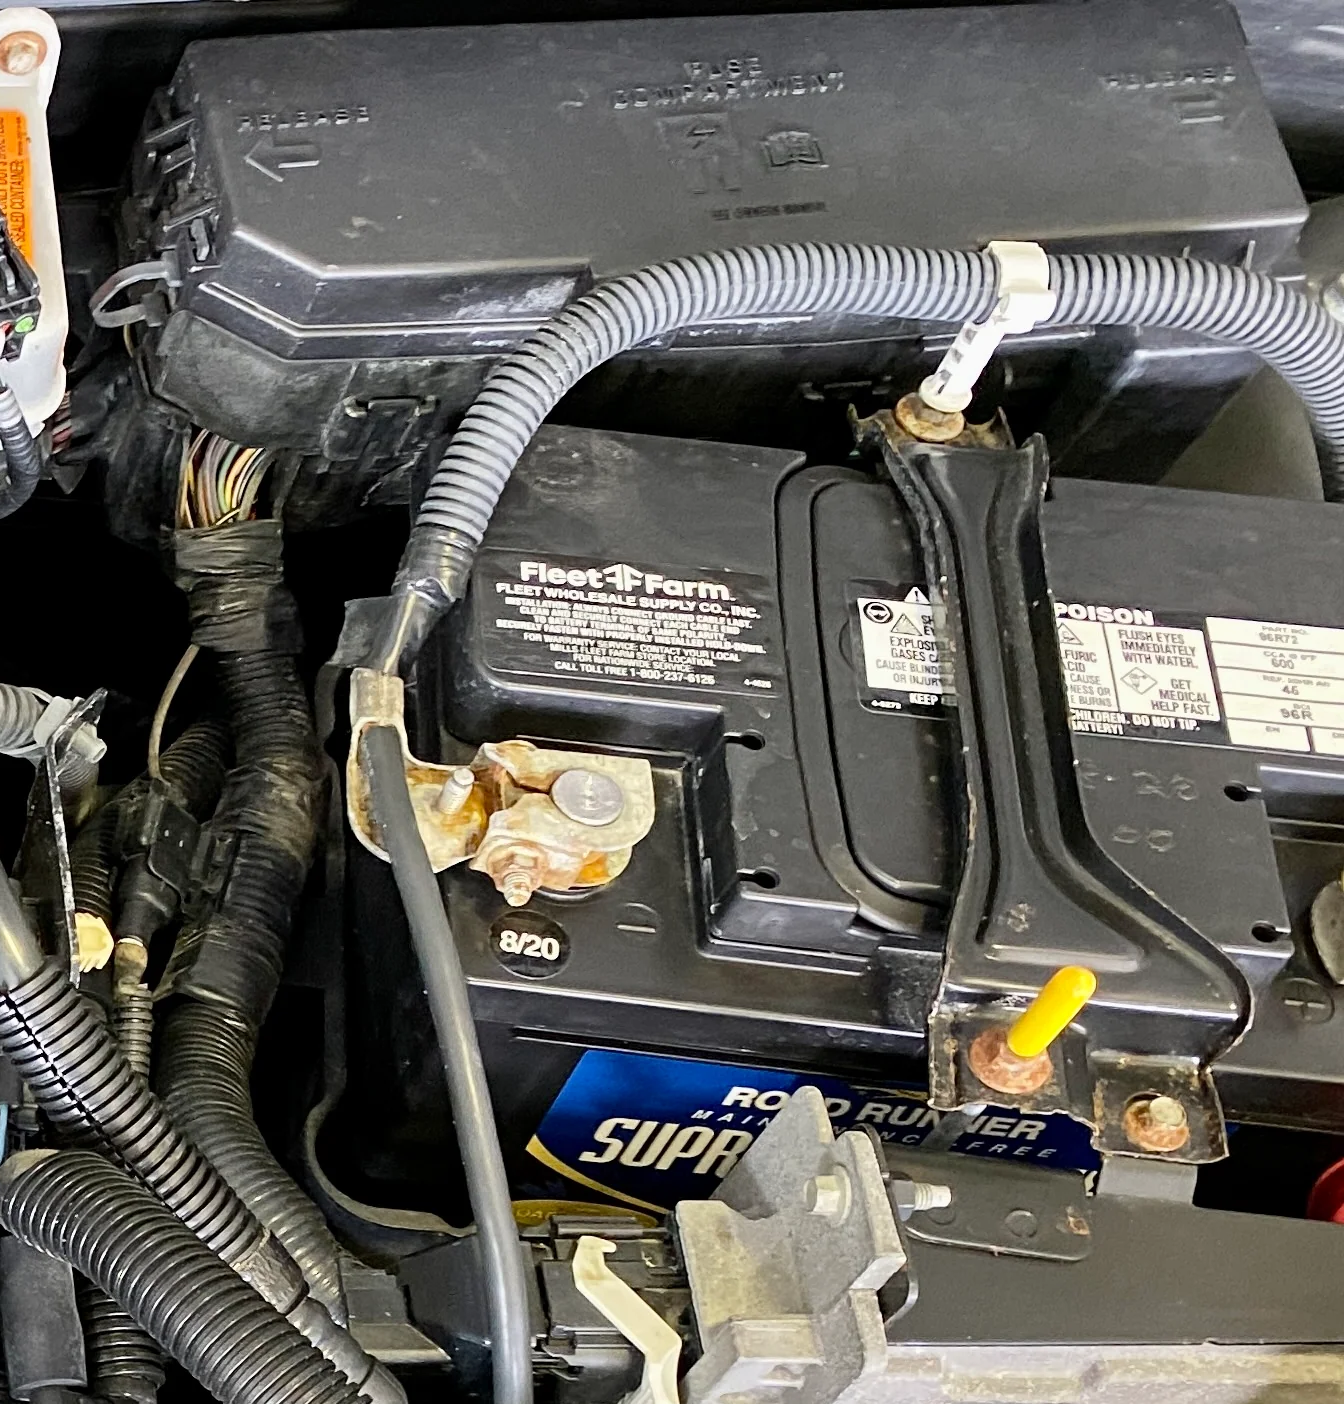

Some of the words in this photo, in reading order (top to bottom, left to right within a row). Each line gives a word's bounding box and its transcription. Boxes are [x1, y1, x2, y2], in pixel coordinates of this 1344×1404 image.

[520, 561, 604, 589] Fleet
[645, 573, 731, 601] Farm
[496, 582, 543, 596] FLEET
[543, 586, 637, 606] WHOLESALE
[639, 597, 696, 612] SUPPLY
[731, 605, 762, 620] INC.
[1054, 602, 1154, 626] POISON
[890, 636, 936, 652] EXPLOSI
[1118, 629, 1153, 642] FLUSH
[1156, 632, 1185, 645] EYES
[580, 646, 607, 656] FLEET
[609, 648, 635, 660] FARM
[636, 651, 666, 662] STORE
[682, 648, 709, 659] YOUR
[891, 648, 926, 662] GASES
[1064, 649, 1097, 663] FURIC
[1121, 640, 1197, 657] IMMEDIATELY
[876, 659, 907, 672] CAUSE
[1122, 651, 1153, 664] WITH
[1155, 655, 1199, 669] WATER.
[1271, 658, 1295, 670] 600
[554, 660, 578, 671] CALL
[579, 663, 603, 674] TOLL
[604, 666, 628, 677] FREE
[893, 673, 907, 684] OR
[910, 674, 939, 687] INJUR
[1070, 672, 1101, 685] CAUSE
[1170, 679, 1192, 691] GET
[1097, 686, 1111, 697] OR
[1159, 688, 1211, 704] MEDICAL
[1079, 695, 1112, 708] BURNS
[1151, 699, 1180, 713] HELP
[1183, 703, 1214, 717] FAST.
[1132, 714, 1150, 726] DO
[1152, 715, 1177, 729] NOT
[1177, 718, 1201, 731] TIP.
[1279, 708, 1314, 721] 96R
[498, 927, 561, 961] 8/20
[721, 1085, 853, 1118] ROD
[579, 1116, 754, 1180] SUPR
